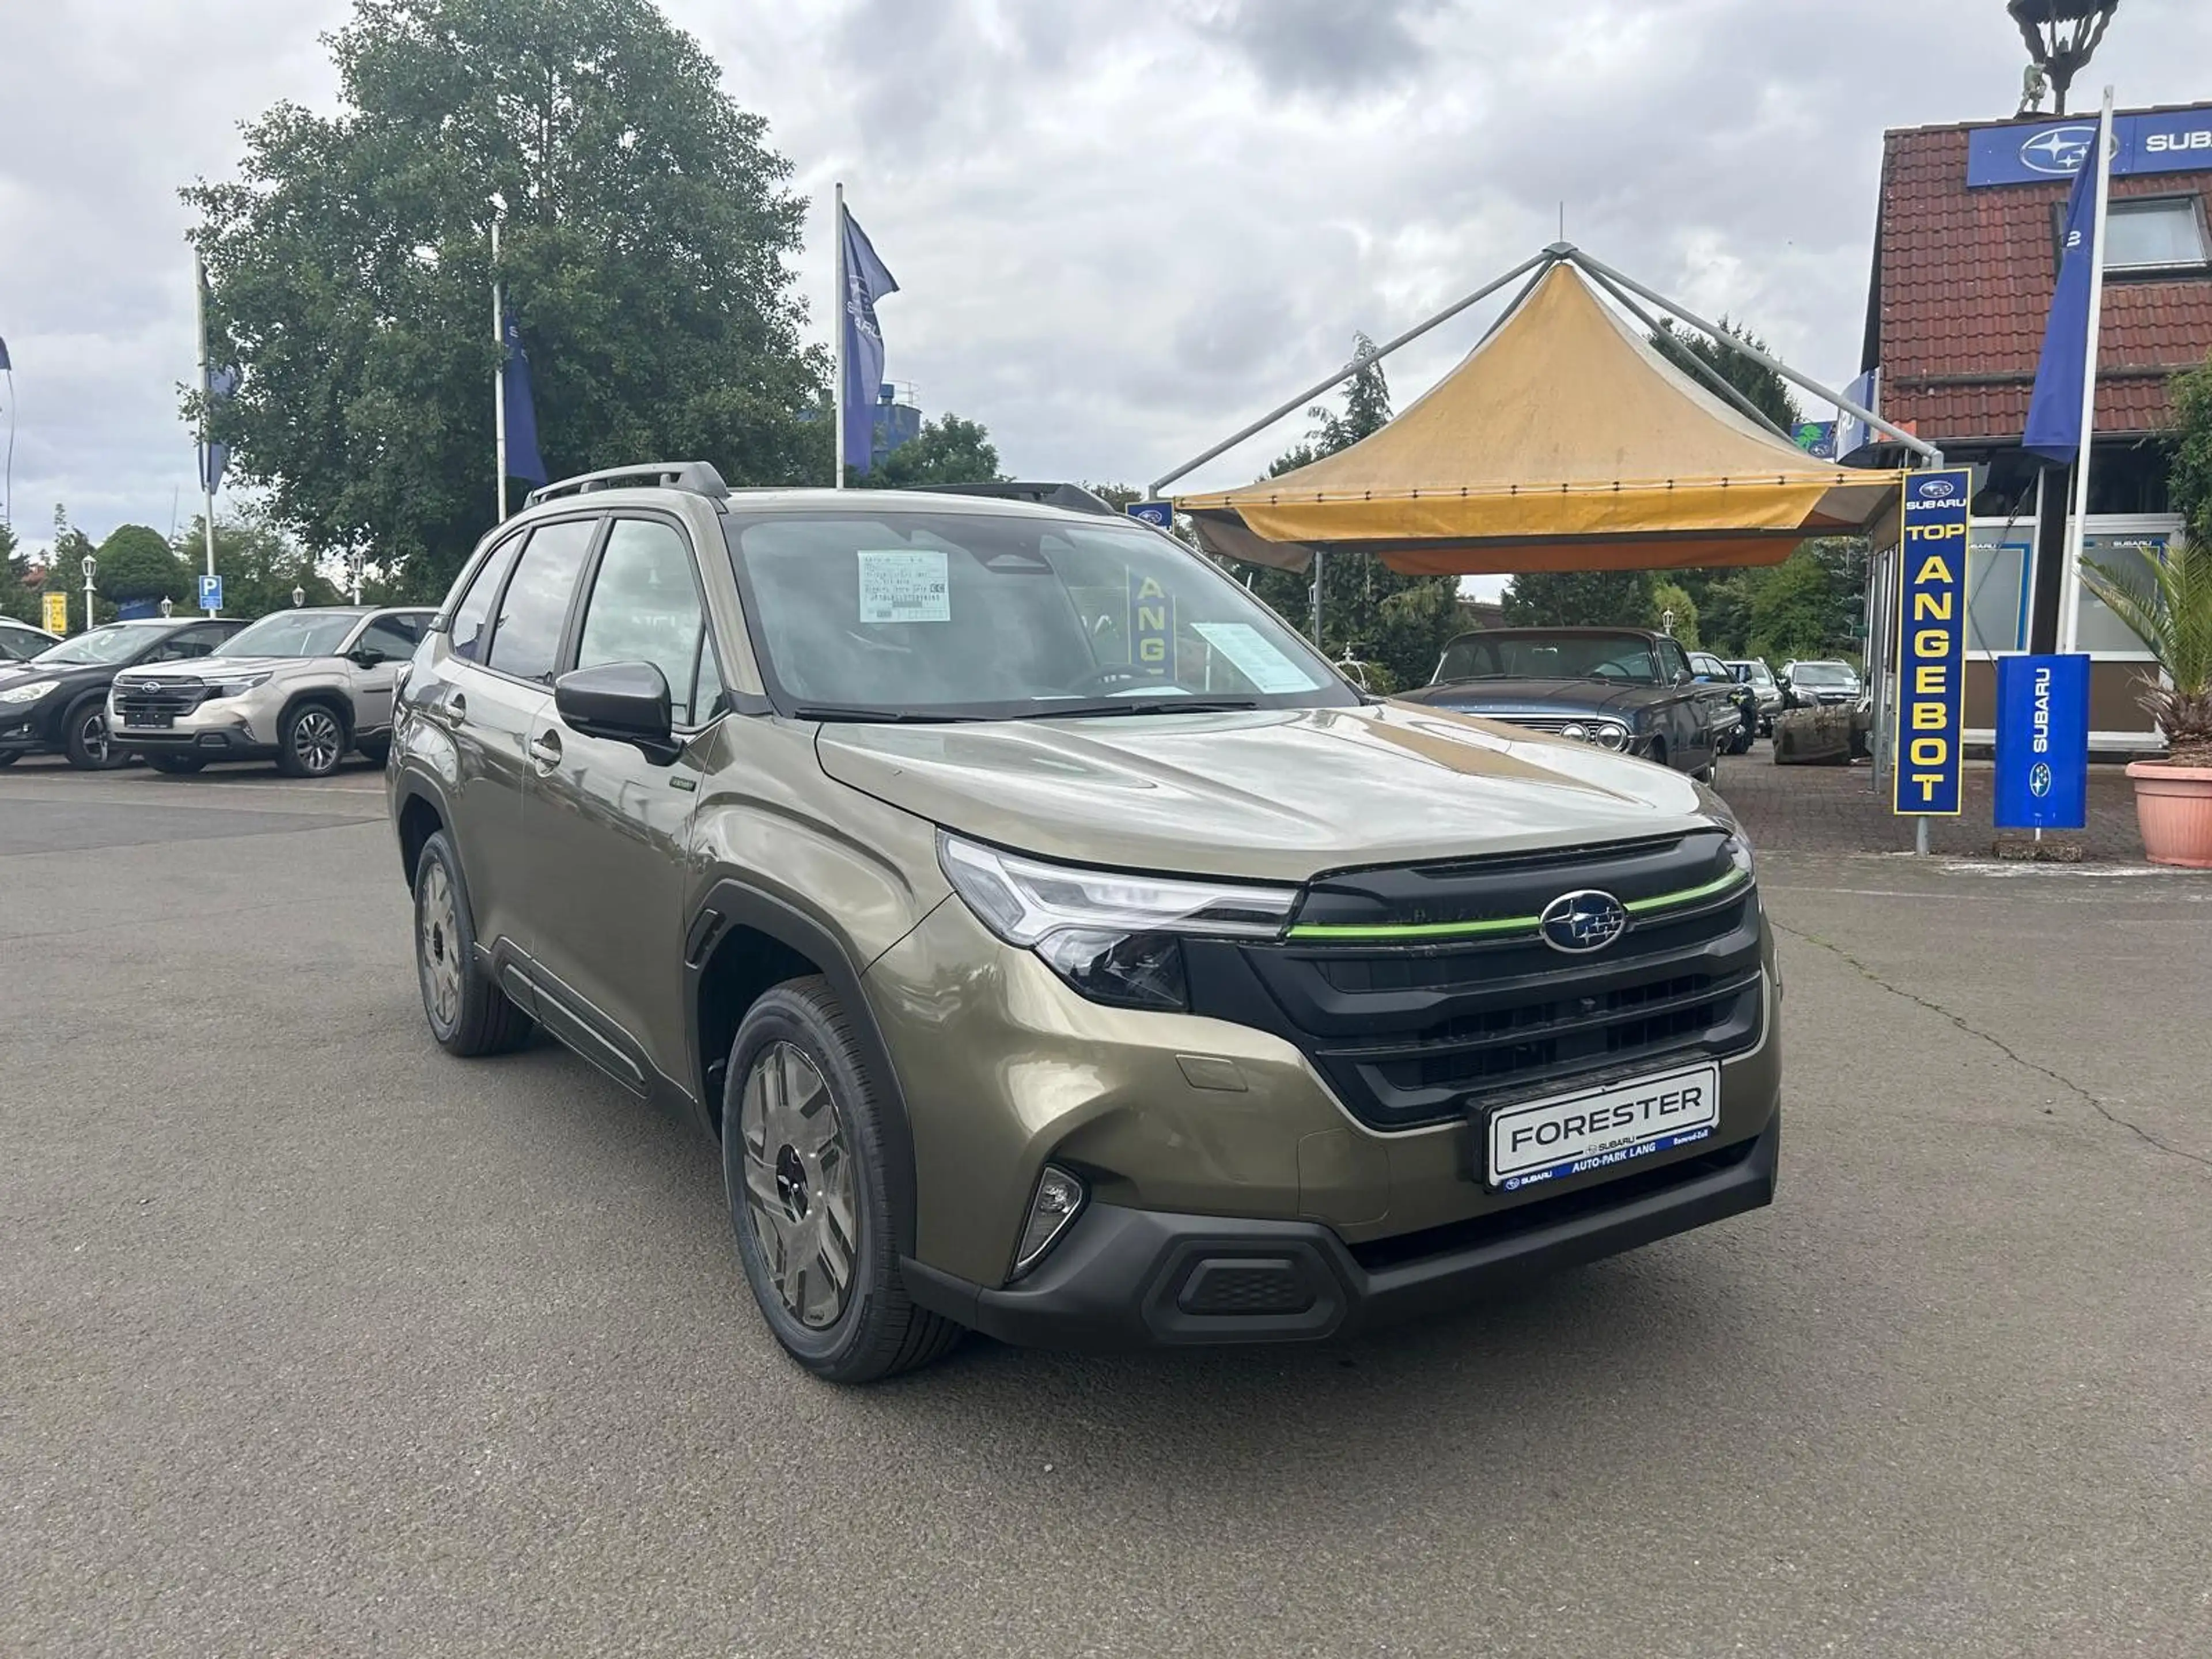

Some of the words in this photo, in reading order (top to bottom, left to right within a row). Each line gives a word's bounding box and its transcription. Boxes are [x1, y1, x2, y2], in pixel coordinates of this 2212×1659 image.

[2146, 131, 2212, 152] SUB
[1906, 498, 1967, 510] SUBARU
[1906, 523, 1965, 540] TOP
[203, 578, 217, 595] P
[1137, 576, 1165, 675] ANG
[1910, 555, 1953, 801] ANGEBOT
[2033, 668, 2050, 753] SUBARU
[1511, 1086, 1703, 1153] FORESTER
[1599, 1137, 1635, 1152] SUBARU
[1571, 1150, 1627, 1173] AUTO-PARK
[1630, 1142, 1656, 1158] LANG
[1521, 1171, 1552, 1184] SUBARU
